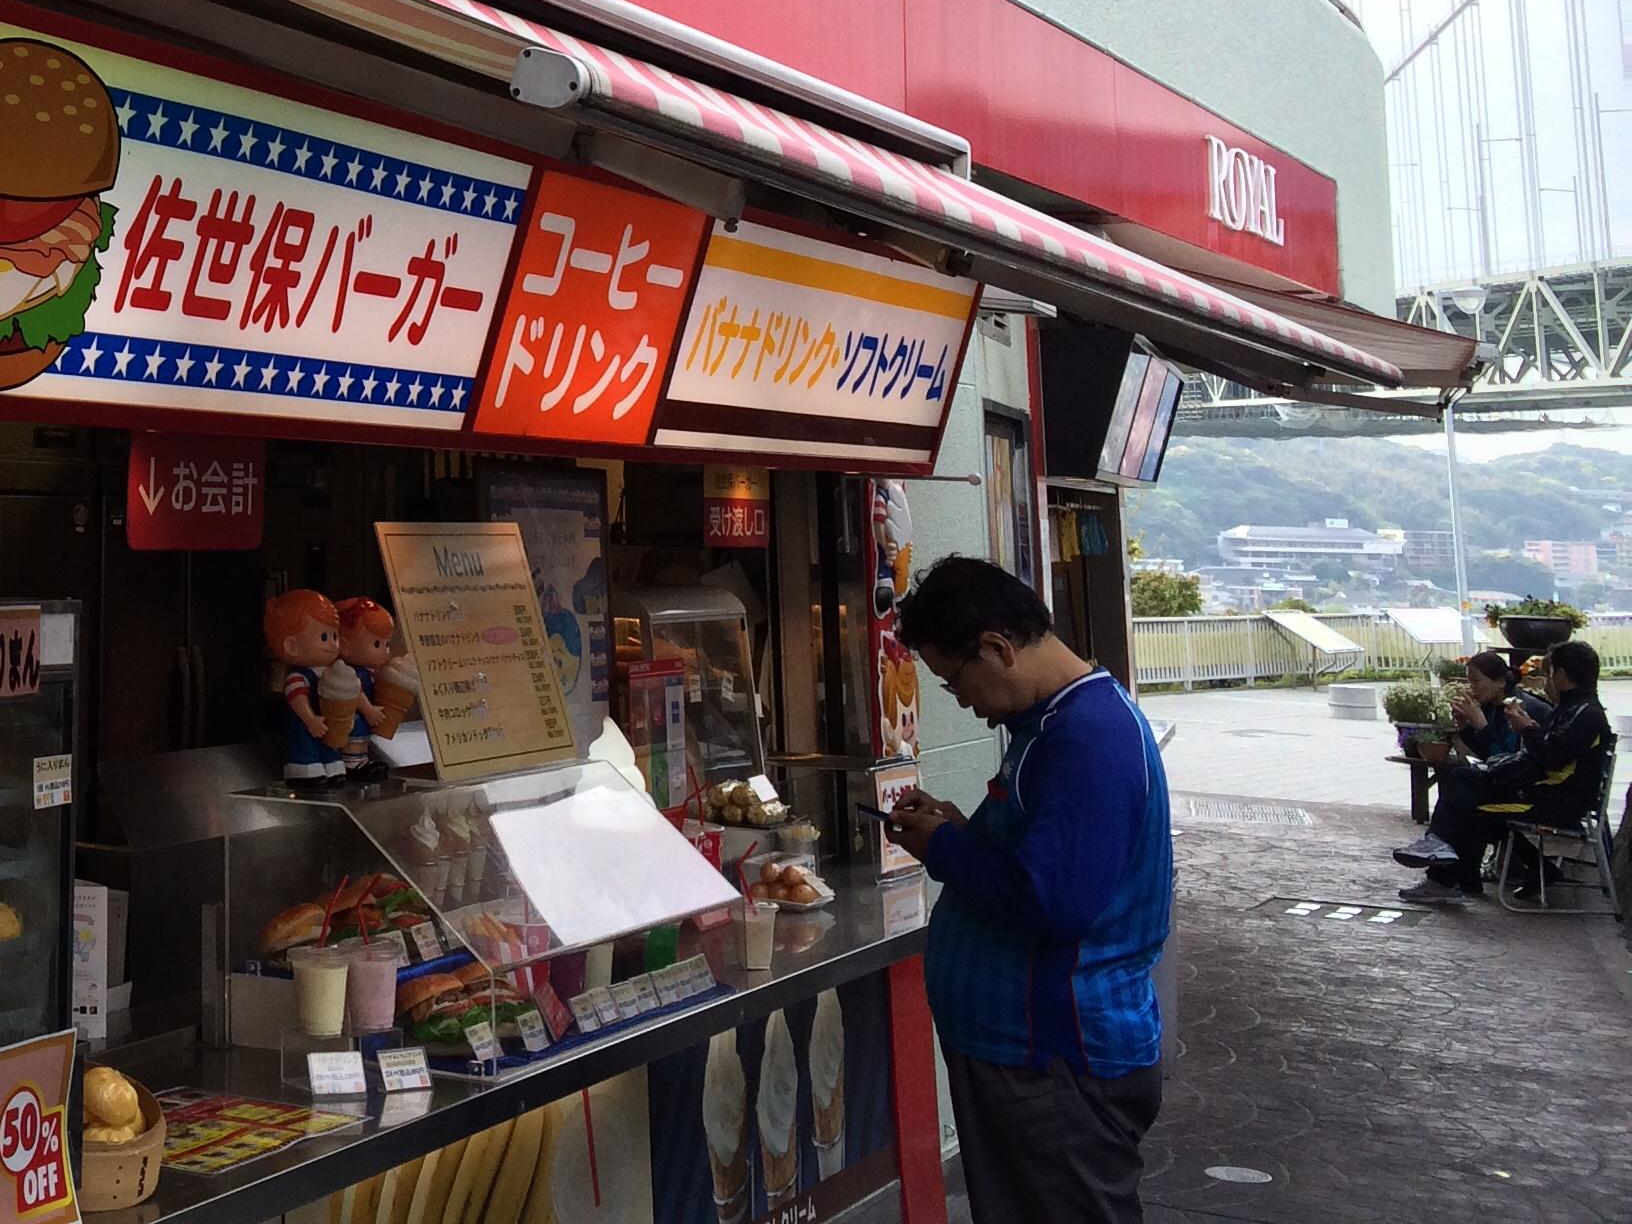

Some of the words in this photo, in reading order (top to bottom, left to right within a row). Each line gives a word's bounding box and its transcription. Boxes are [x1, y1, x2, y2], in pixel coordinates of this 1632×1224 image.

[1205, 134, 1285, 246] ROYAL
[113, 173, 483, 346] 佐世保バーガー
[521, 211, 684, 311] コーヒー
[494, 313, 659, 422] ドリンク
[171, 461, 258, 516] お会計
[709, 506, 765, 537] 受け渡し口
[433, 546, 485, 577] Menu
[2, 1102, 59, 1159] 50%
[23, 1161, 58, 1205] OFF
